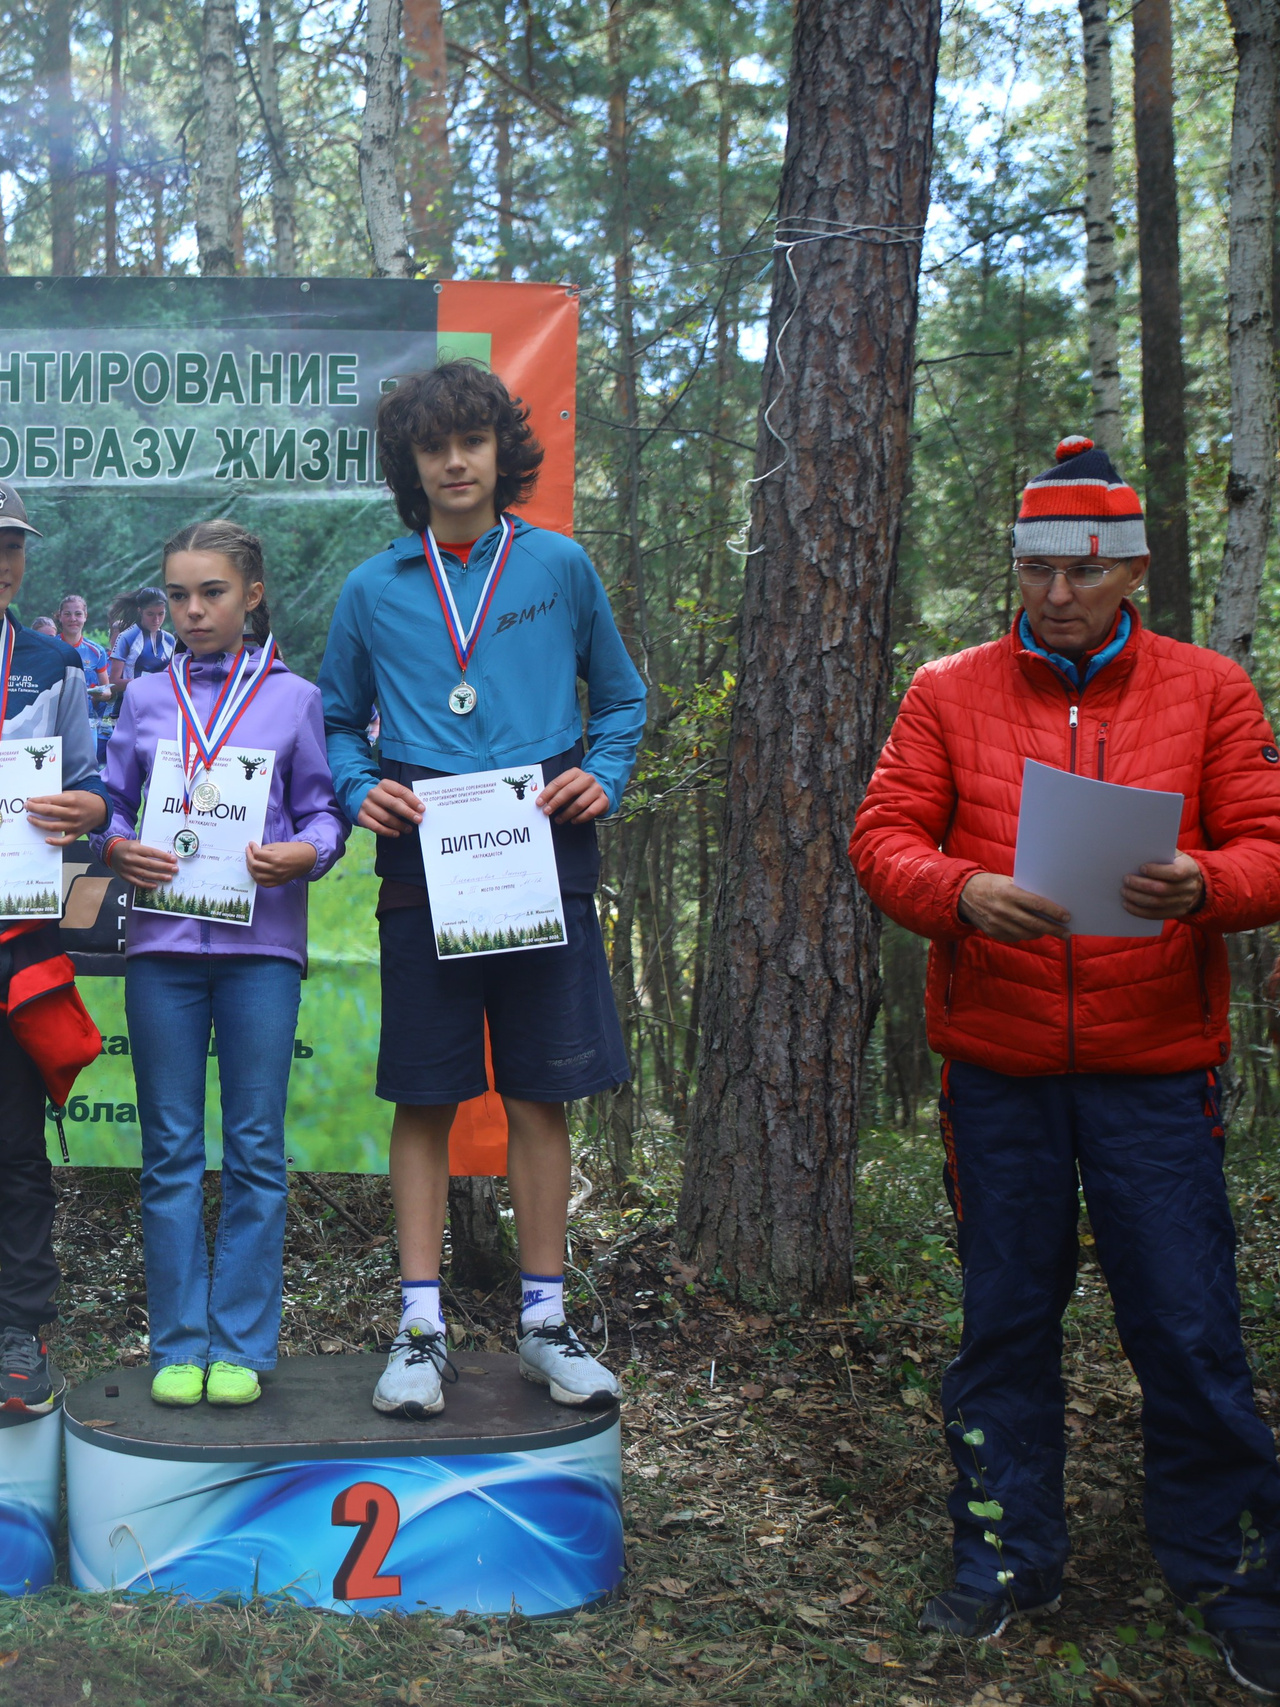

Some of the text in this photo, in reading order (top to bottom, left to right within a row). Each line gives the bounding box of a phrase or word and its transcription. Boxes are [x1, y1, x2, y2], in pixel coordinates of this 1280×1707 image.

[441, 827, 531, 855] ДИПЛОМ
[472, 850, 503, 859] НАГРАЖДАЕТСЯ
[46, 1094, 137, 1123] обла
[331, 1481, 401, 1600] 2
